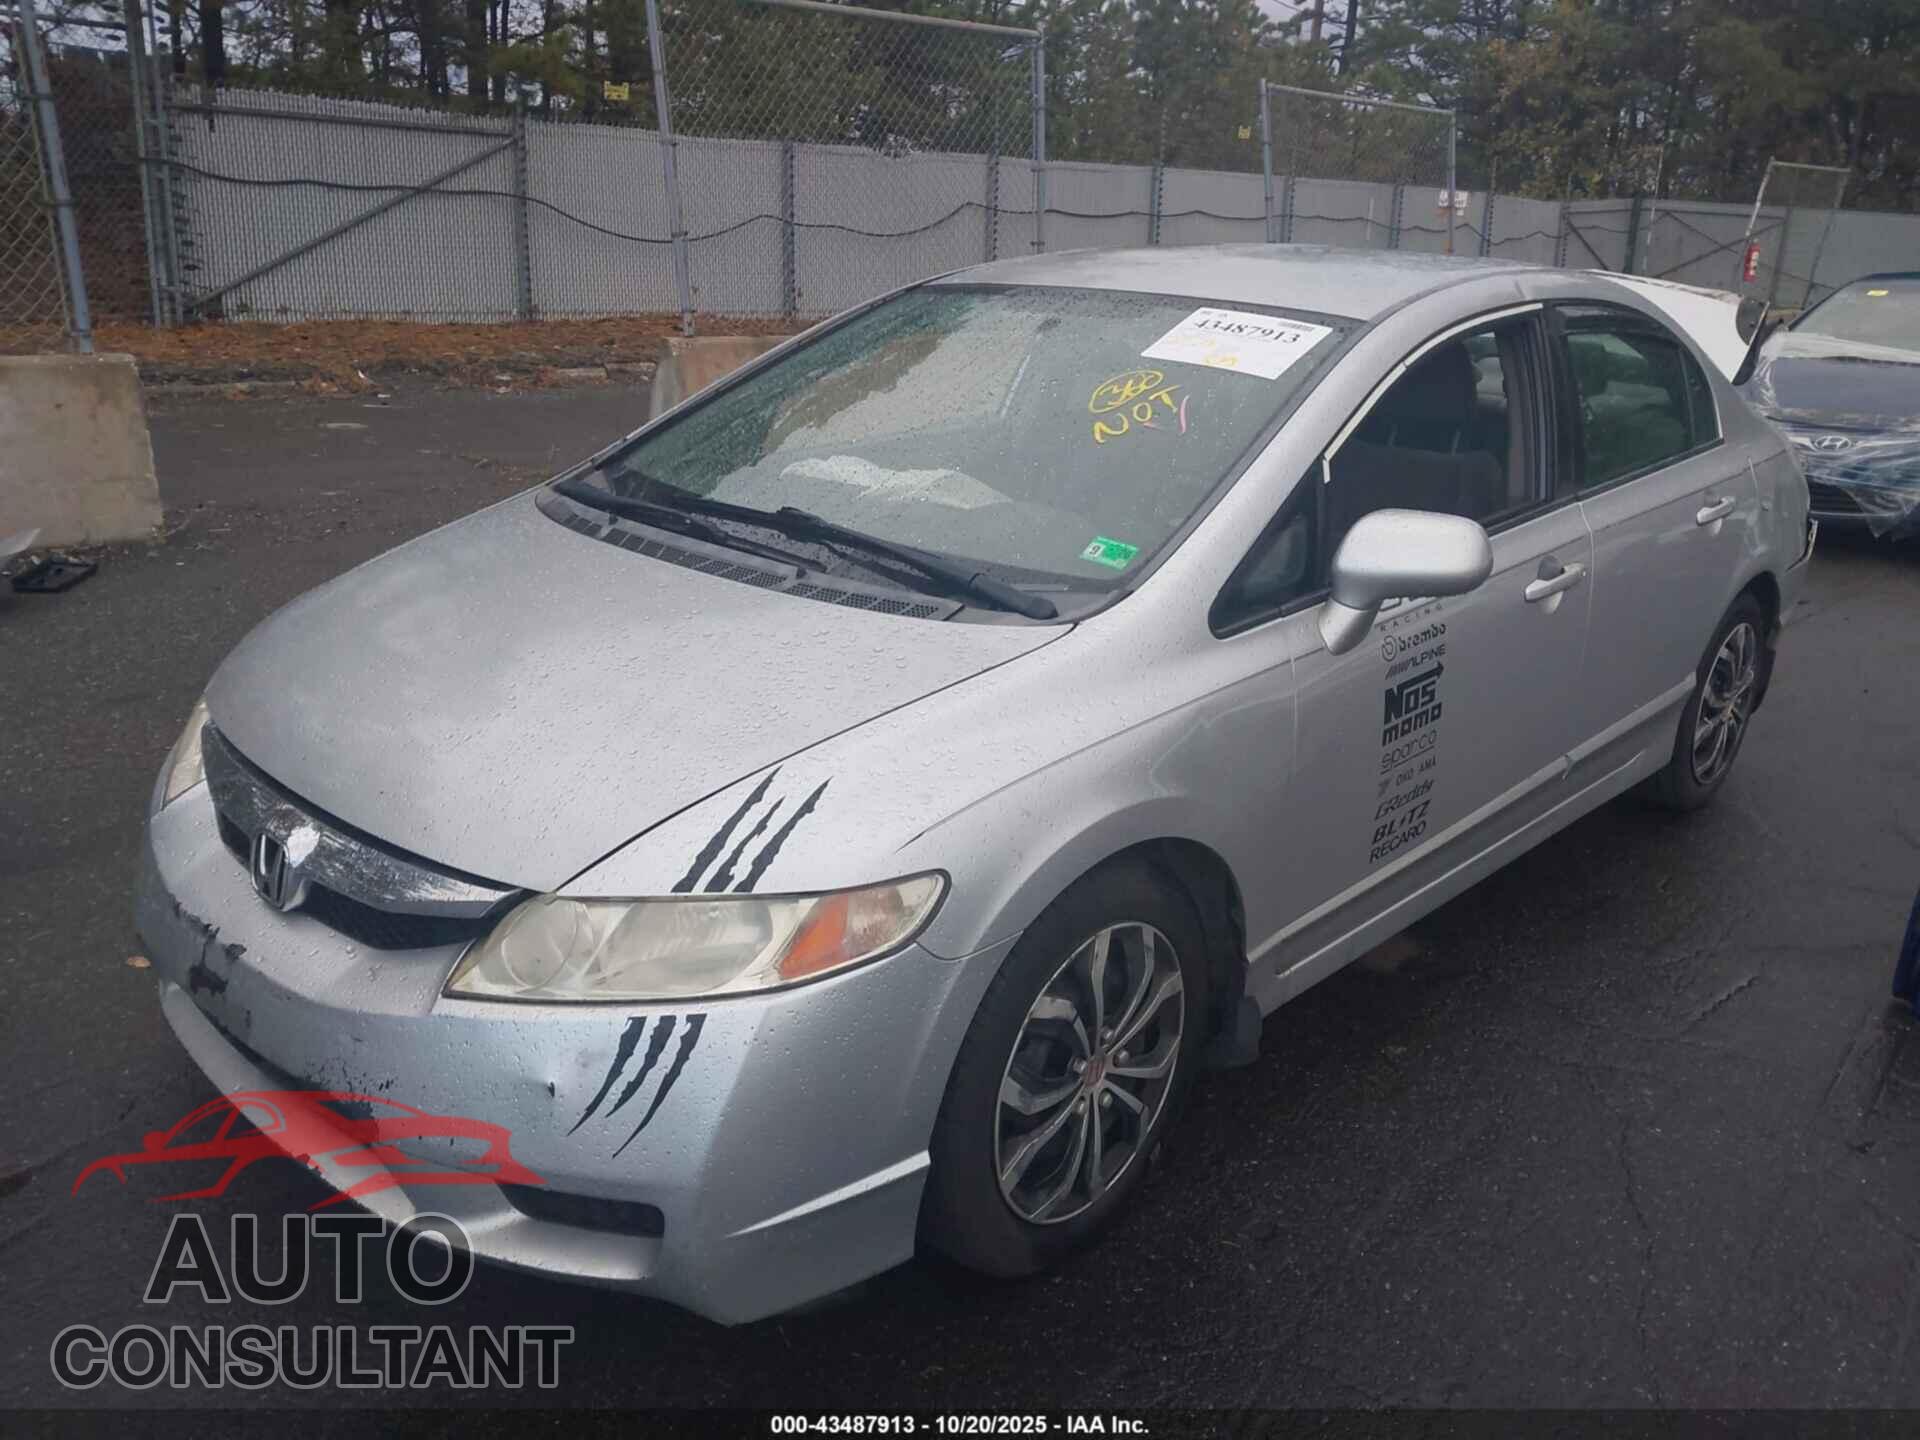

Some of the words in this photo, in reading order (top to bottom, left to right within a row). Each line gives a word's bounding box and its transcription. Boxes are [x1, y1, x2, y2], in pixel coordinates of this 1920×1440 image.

[1194, 318, 1300, 344] 43487913
[1398, 623, 1447, 651] brembo
[1380, 730, 1437, 769] sparco
[1369, 819, 1427, 864] RECARO
